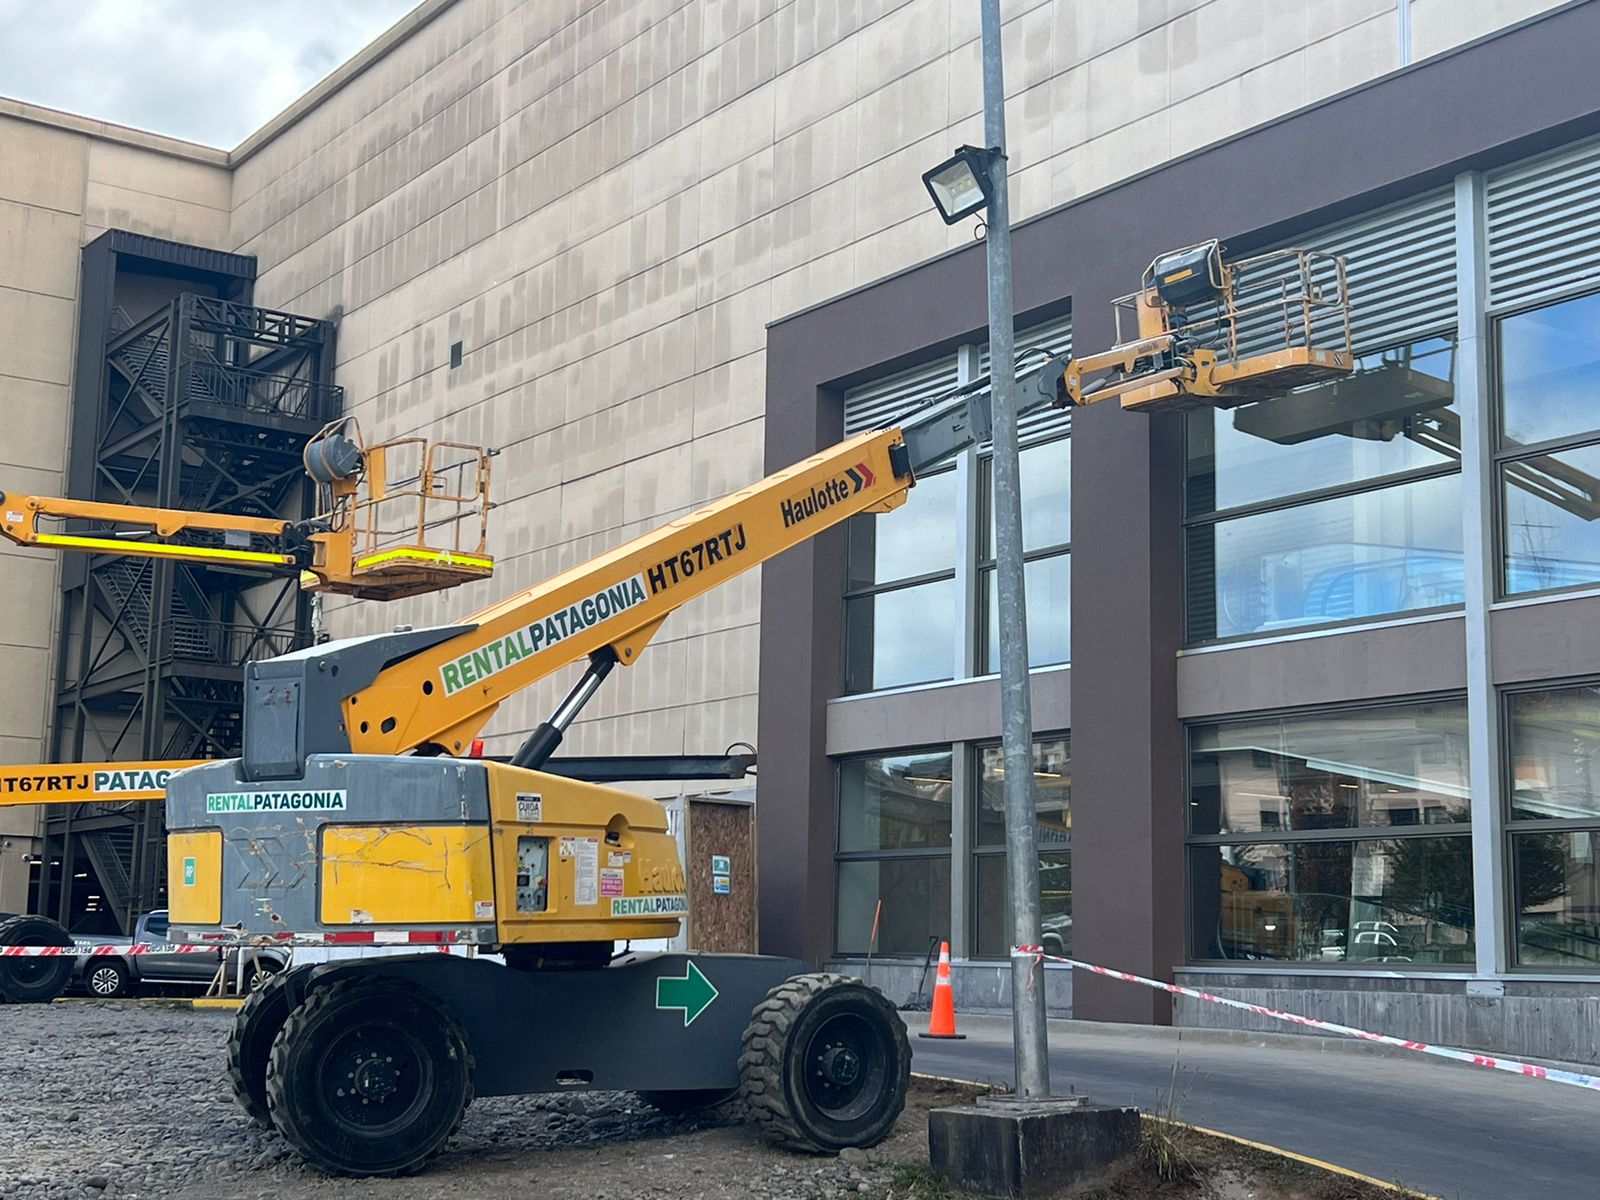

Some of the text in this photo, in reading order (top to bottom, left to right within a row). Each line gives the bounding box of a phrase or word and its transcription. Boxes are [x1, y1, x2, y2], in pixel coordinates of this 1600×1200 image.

[780, 477, 849, 529] Haulotte
[647, 523, 747, 595] HT67RTJ
[441, 577, 646, 694] RENTALPATAGONIA
[0, 774, 89, 793] T67RTJ
[207, 791, 344, 812] RENTALPATAGONIA
